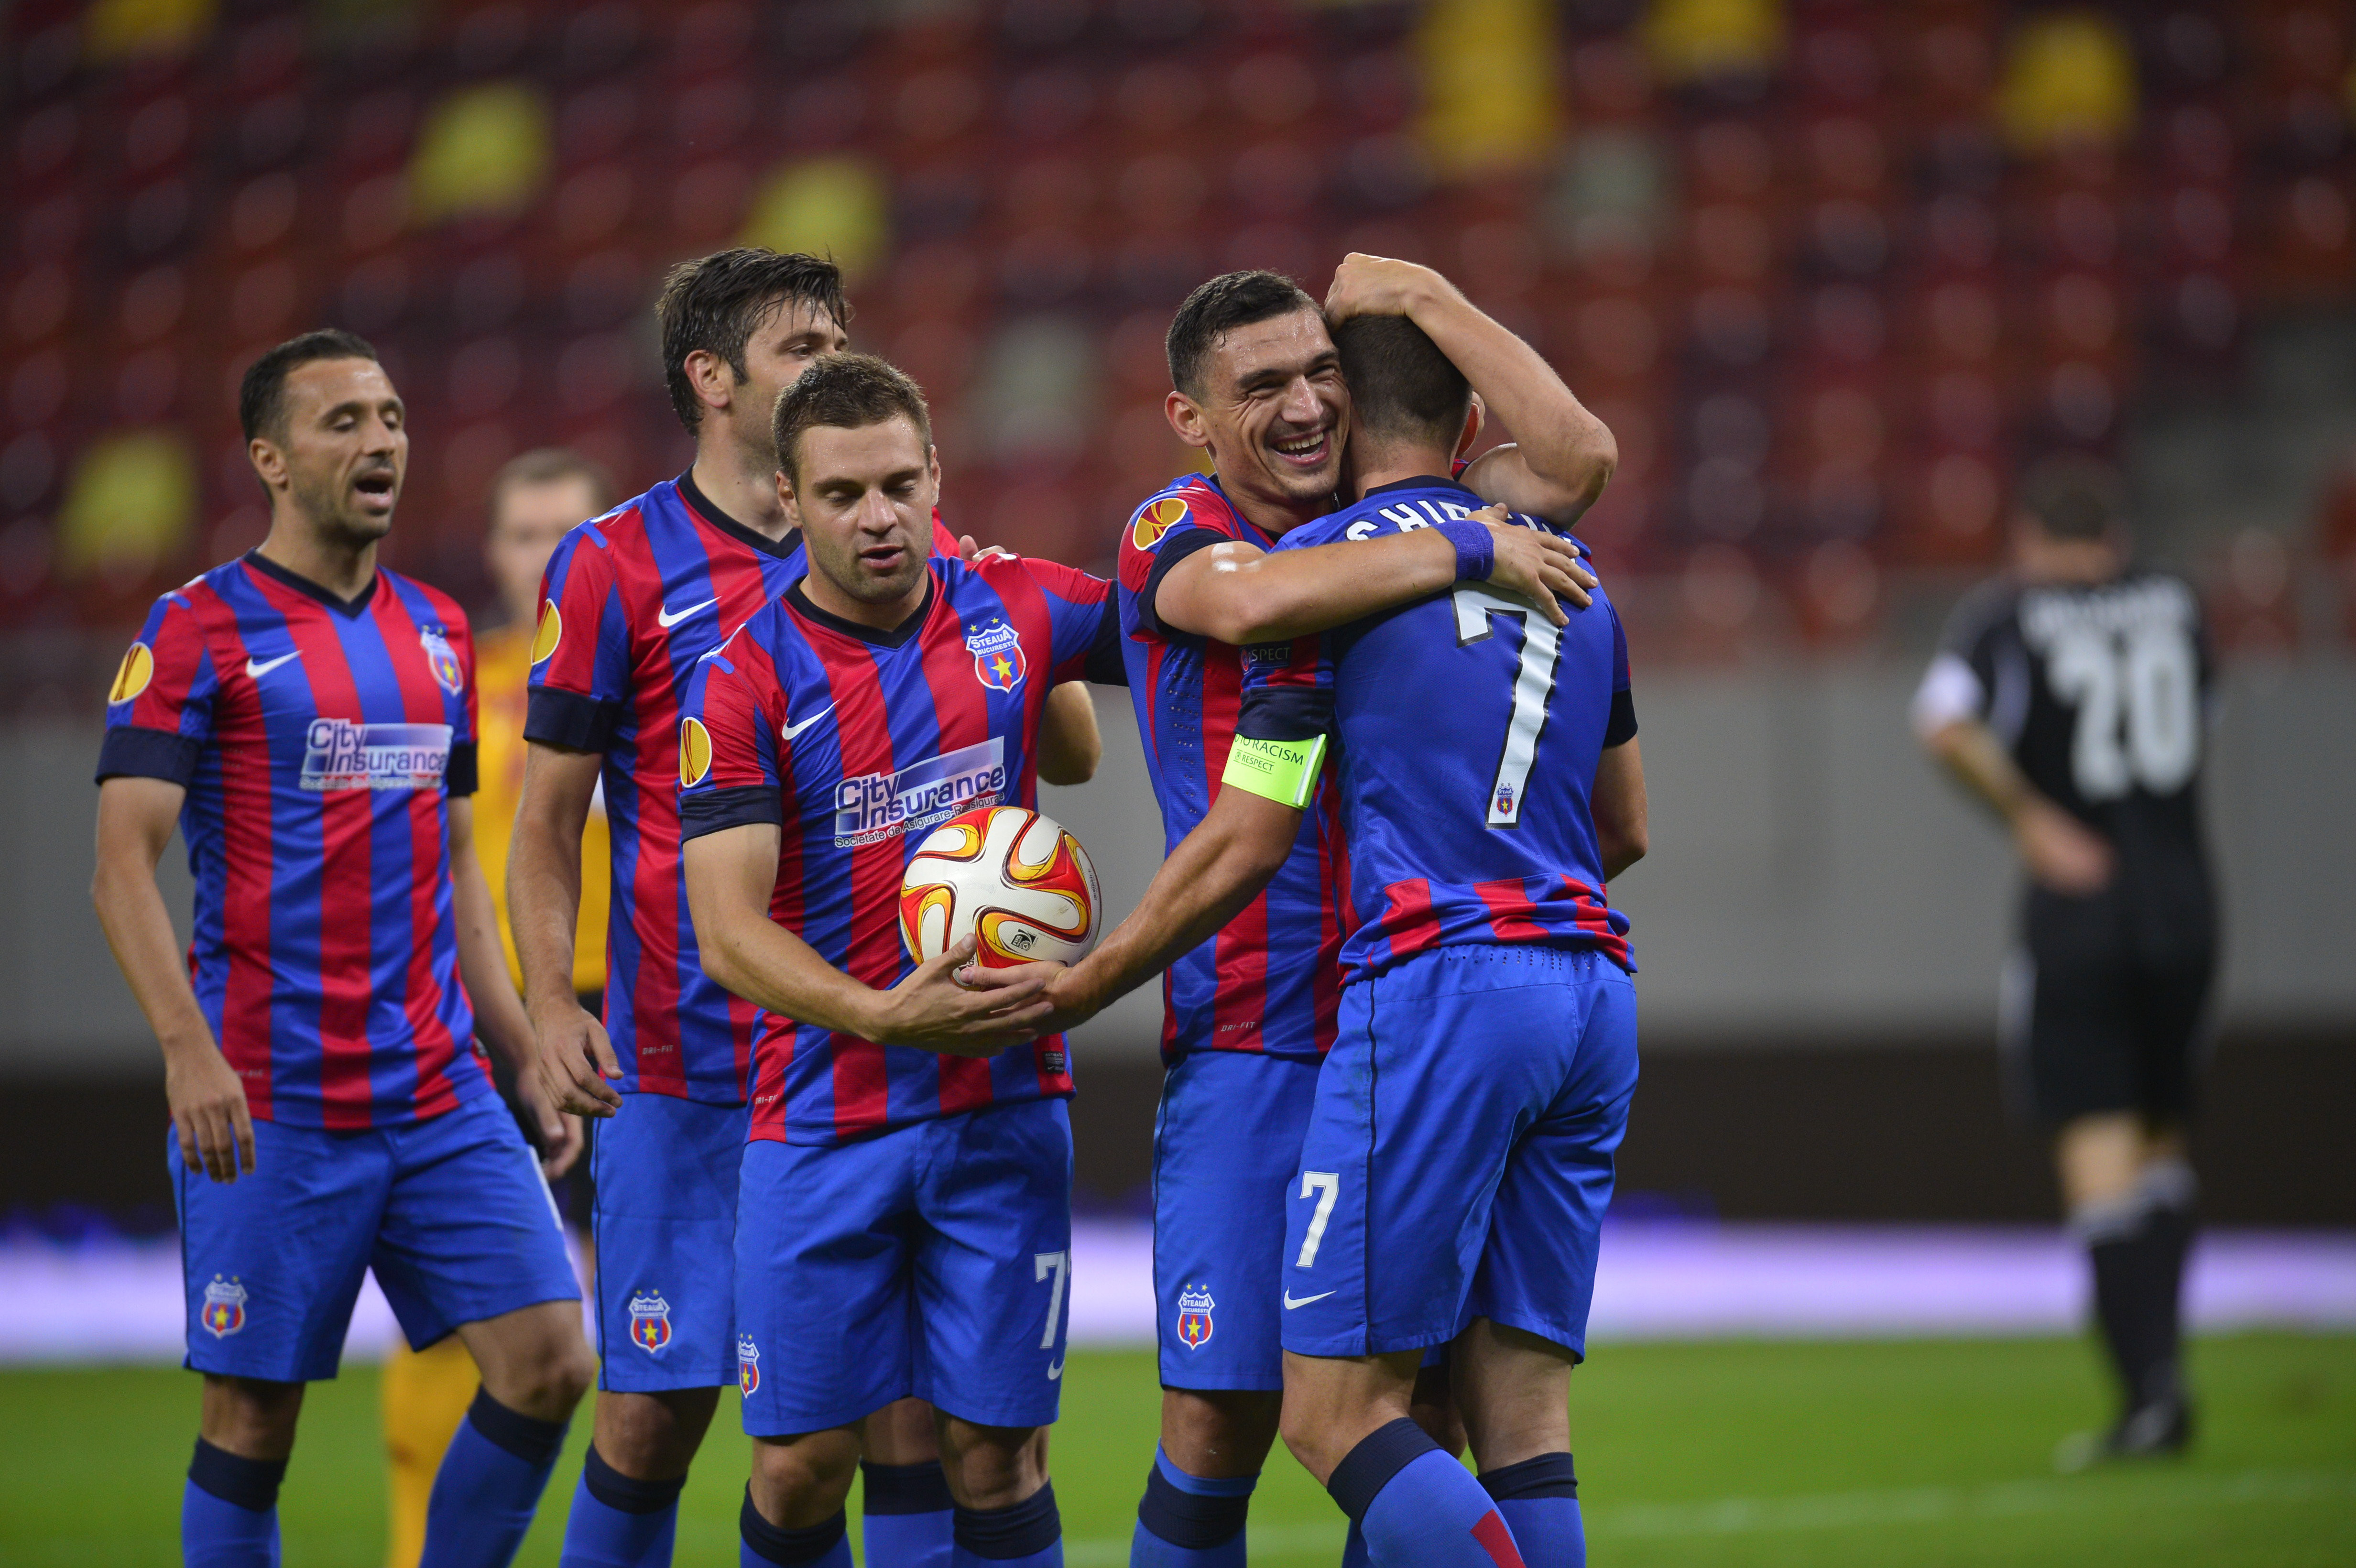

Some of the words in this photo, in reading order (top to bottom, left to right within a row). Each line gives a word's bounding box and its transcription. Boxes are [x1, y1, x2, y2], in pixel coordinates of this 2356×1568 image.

[971, 629, 1013, 648] STEAUA
[1450, 578, 1564, 830] 7
[310, 723, 364, 751] City
[1242, 754, 1274, 772] RESPECT
[838, 774, 901, 809] City
[862, 766, 1004, 829] Insurance
[836, 831, 885, 847] Societate
[889, 825, 901, 837] de
[1221, 1022, 1255, 1032] DRI-FIT
[642, 1045, 673, 1055] DRI-FIT
[1296, 1171, 1339, 1267] 7
[1182, 1296, 1210, 1307] STEAUA
